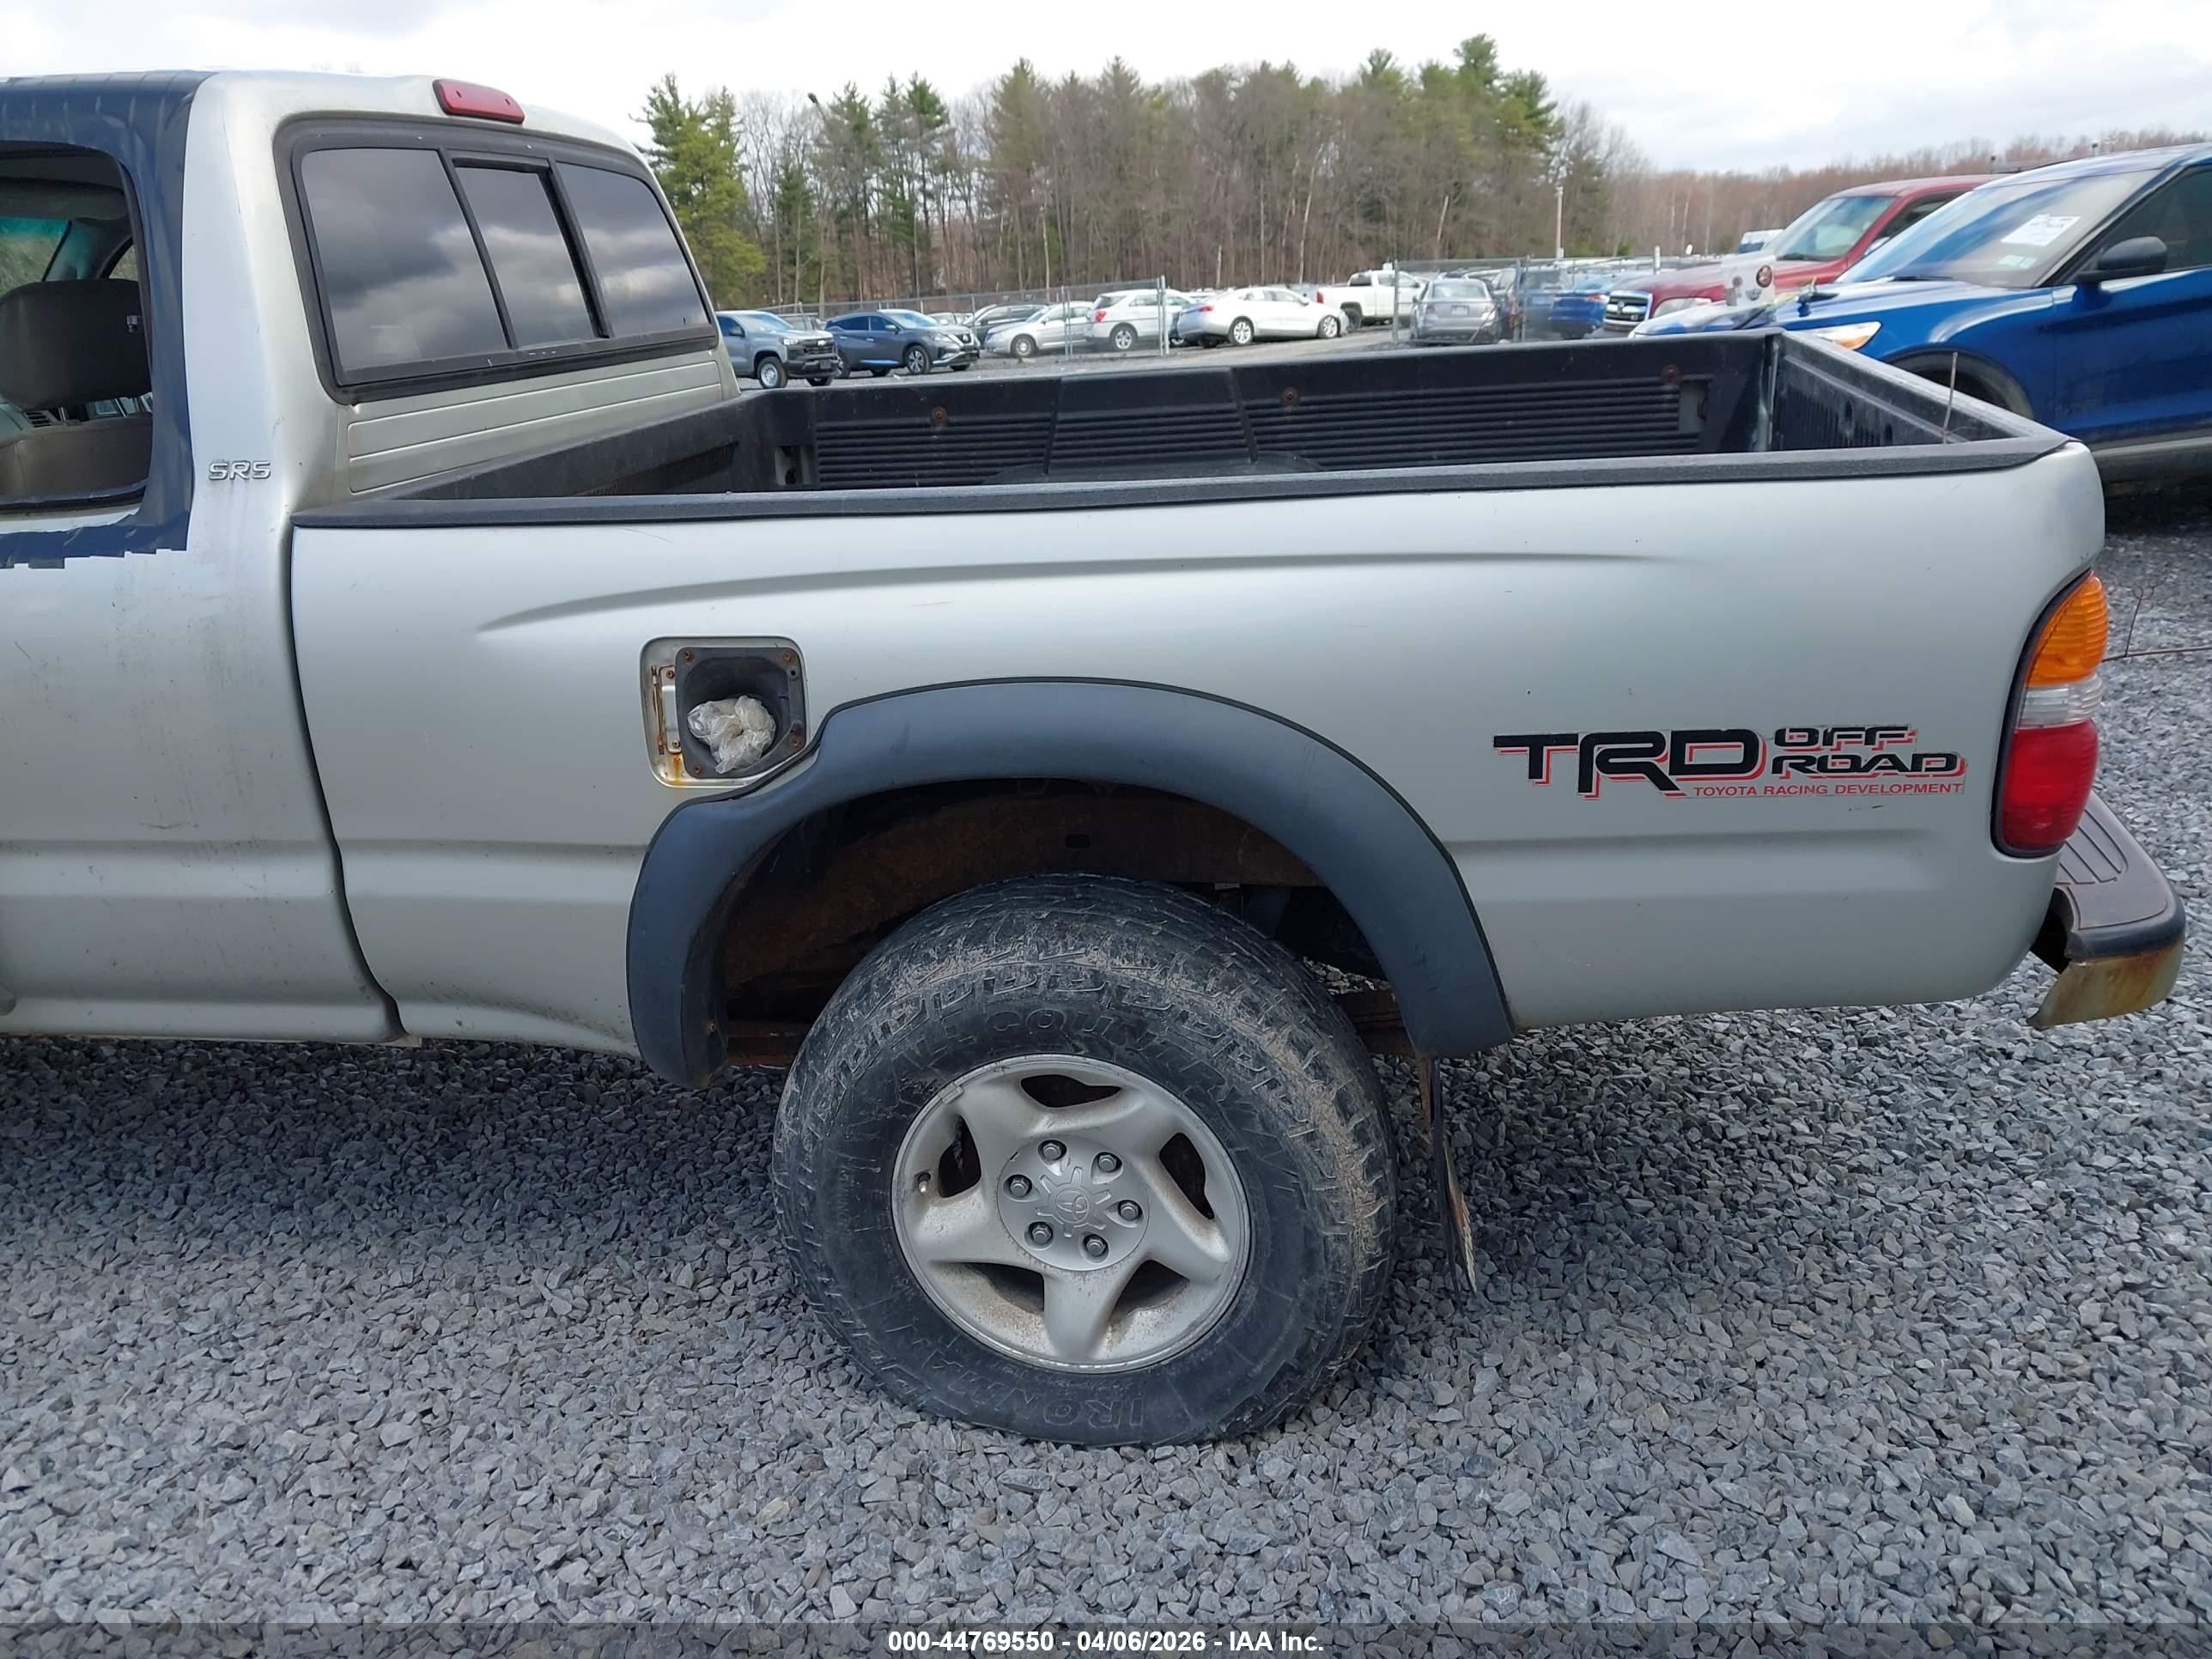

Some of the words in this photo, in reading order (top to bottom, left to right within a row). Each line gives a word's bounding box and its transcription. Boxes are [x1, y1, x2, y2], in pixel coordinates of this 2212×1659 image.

[1774, 726, 1915, 750] OFF
[1493, 729, 1765, 797] TRD
[1771, 752, 1965, 779] ROAD
[1694, 785, 1757, 797] TOYOTA
[1763, 785, 1828, 796] RACING
[1834, 782, 1965, 795] DEVELOPMENT
